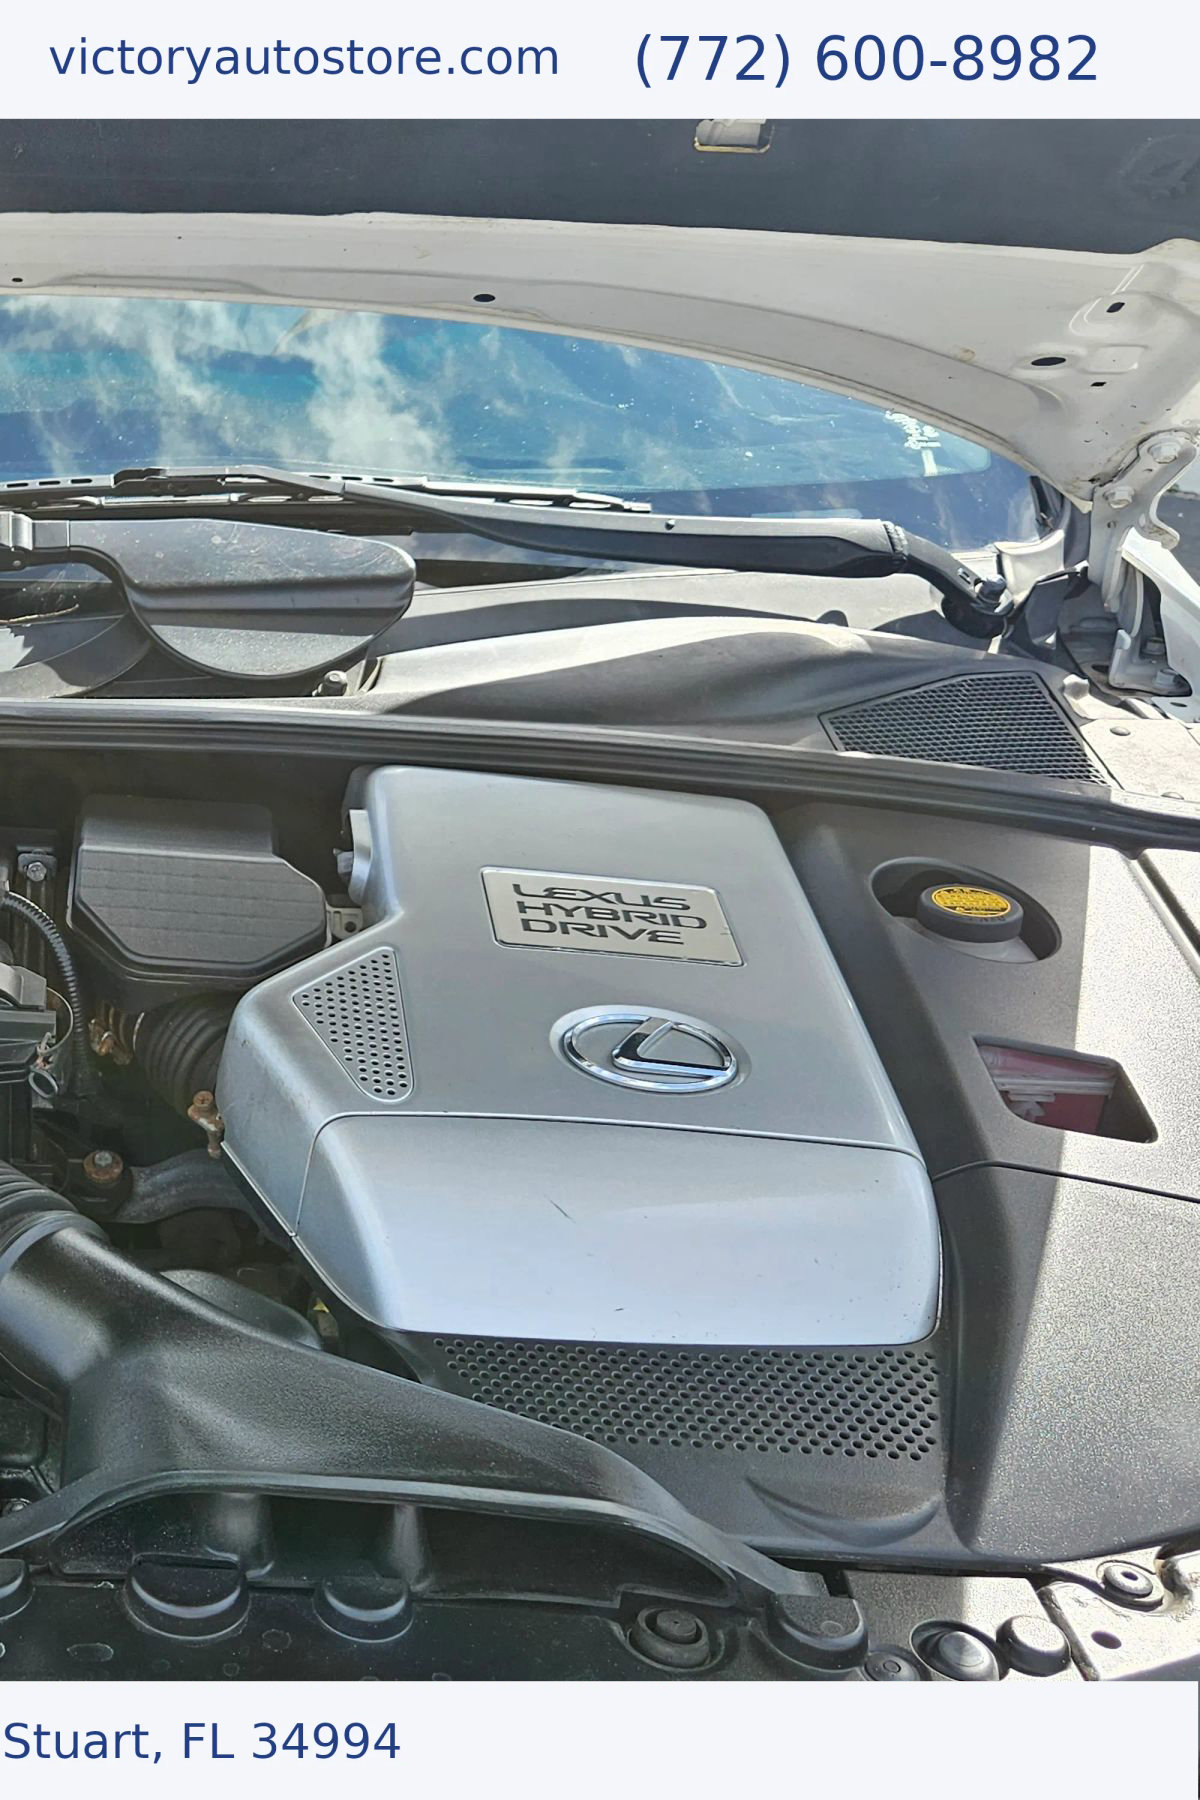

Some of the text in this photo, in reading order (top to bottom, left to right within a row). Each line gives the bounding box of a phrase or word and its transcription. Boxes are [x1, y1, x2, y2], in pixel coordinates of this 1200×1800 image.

[512, 883, 691, 911] LEXUS
[516, 901, 708, 929] HYBRID
[520, 918, 685, 945] DRIVE
